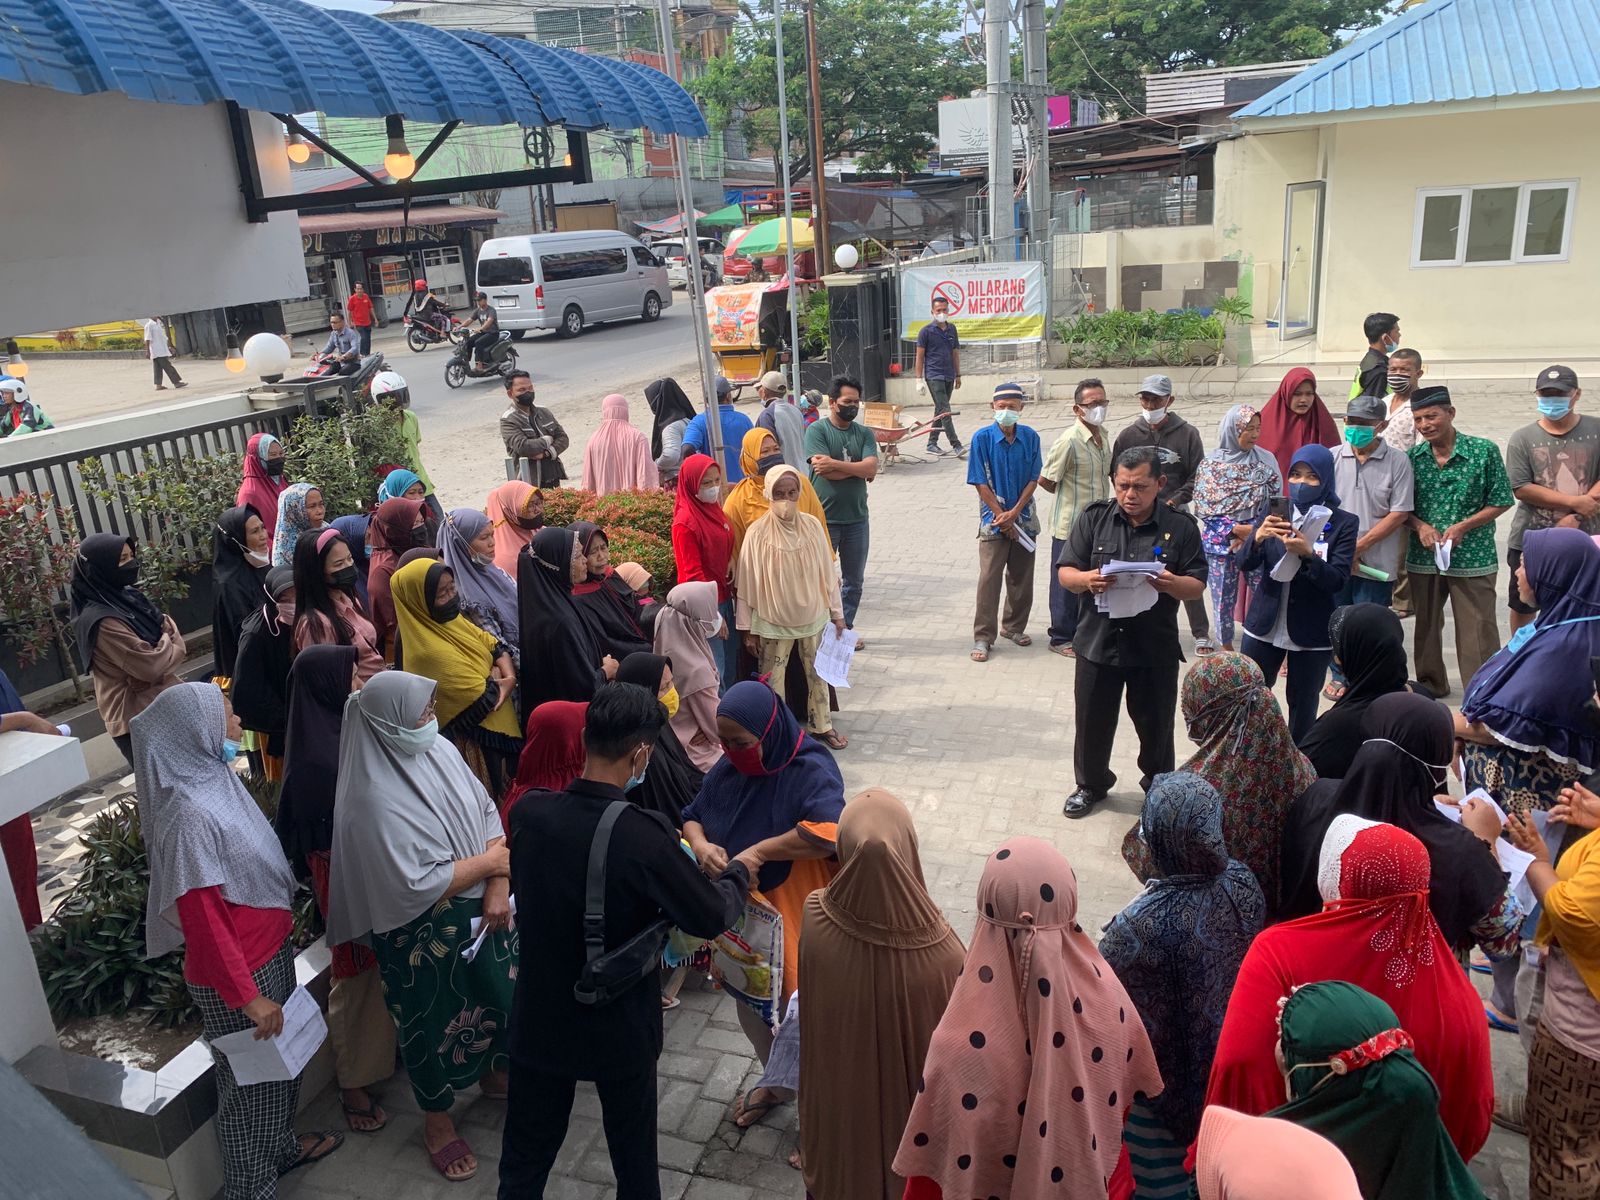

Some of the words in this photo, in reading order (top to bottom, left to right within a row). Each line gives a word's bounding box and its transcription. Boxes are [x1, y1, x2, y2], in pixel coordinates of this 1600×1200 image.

[376, 224, 447, 246] MAMPIR
[968, 278, 1025, 297] DILARANG
[968, 296, 1025, 314] MEROKOK
